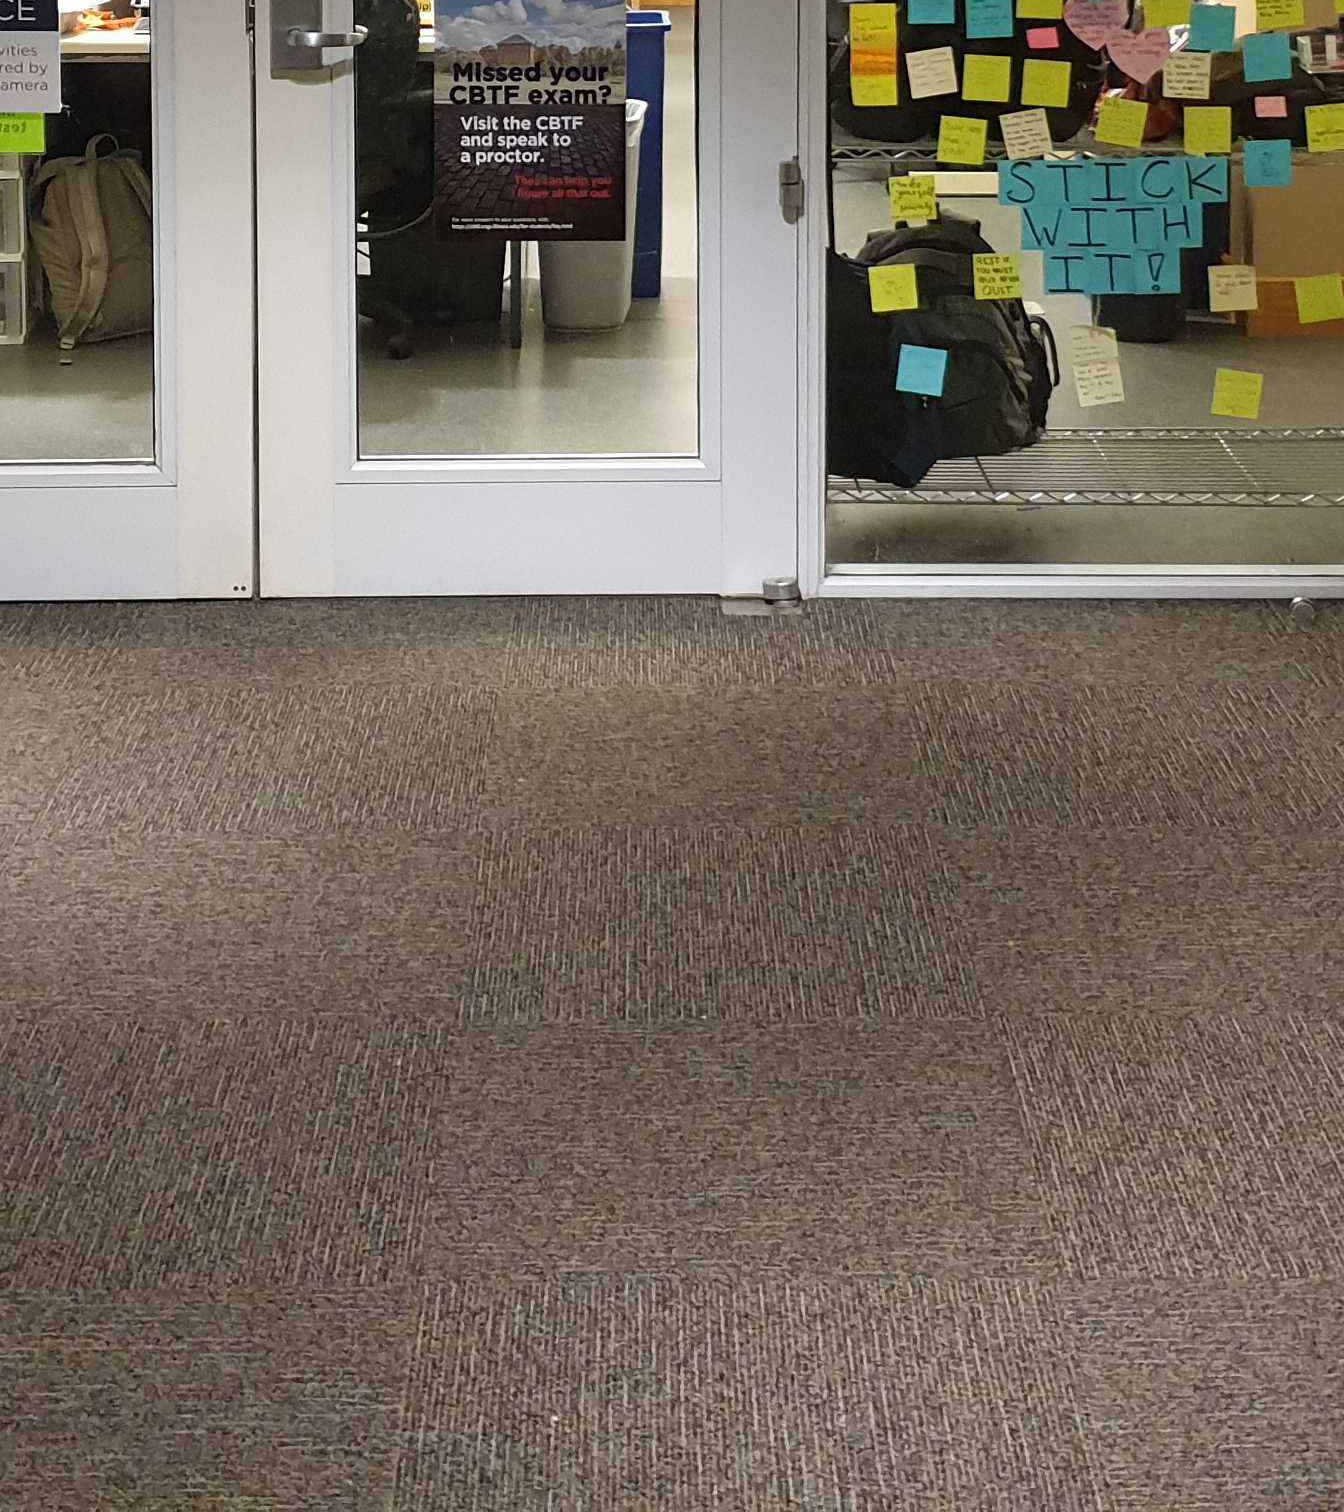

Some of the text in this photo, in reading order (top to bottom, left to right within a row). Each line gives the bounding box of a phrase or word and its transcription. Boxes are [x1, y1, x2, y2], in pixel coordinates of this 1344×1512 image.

[28, 61, 48, 77] by
[452, 62, 609, 86] Missed your
[449, 85, 612, 105] CBTF exam?
[460, 116, 584, 130] Visit the CBTF
[460, 132, 571, 149] and speak to
[461, 150, 545, 165] a proctor.
[1007, 160, 1222, 203] STICK
[1023, 205, 1191, 246] WITH
[1049, 253, 1165, 292] IT!
[982, 285, 1014, 295] QUIT
